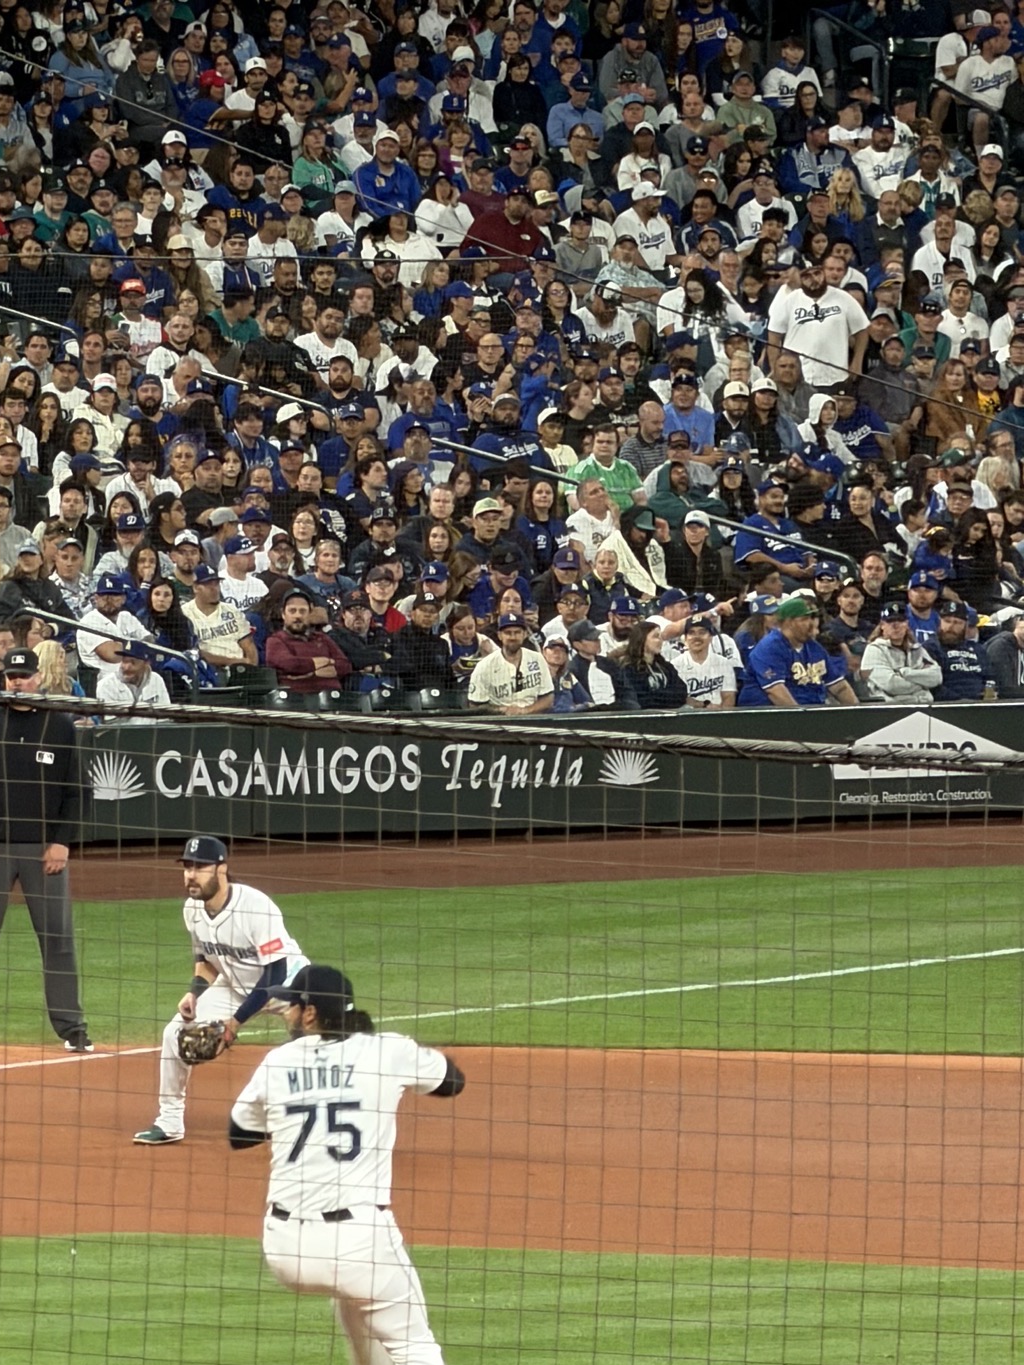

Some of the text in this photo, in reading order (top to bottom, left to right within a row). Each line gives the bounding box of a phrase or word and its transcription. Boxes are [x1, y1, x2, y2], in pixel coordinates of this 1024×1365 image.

[494, 684, 509, 698] LOS
[155, 743, 583, 808] CASAMIGOS Tequila
[936, 788, 993, 801] Construction.
[287, 1056, 355, 1094] MUÑOZ
[285, 1101, 362, 1163] 75
